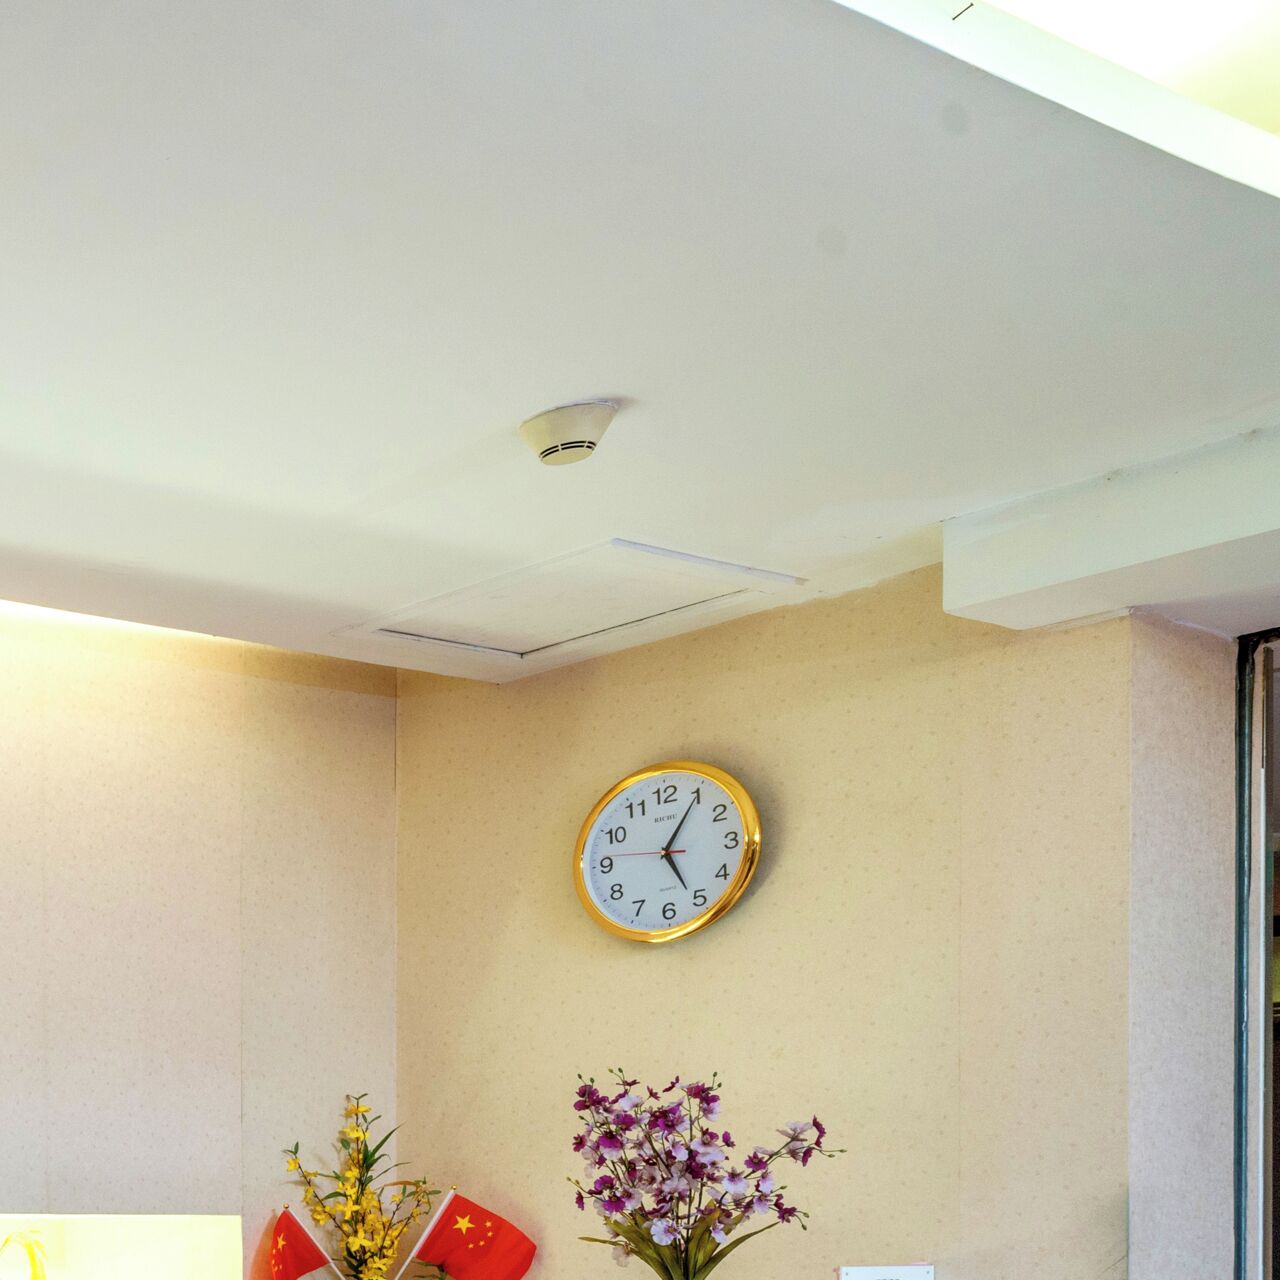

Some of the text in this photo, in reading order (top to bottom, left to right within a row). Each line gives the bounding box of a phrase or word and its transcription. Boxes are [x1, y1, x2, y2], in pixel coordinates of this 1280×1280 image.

[652, 785, 678, 806] 12
[691, 787, 701, 805] 1
[625, 799, 646, 819] 11
[712, 804, 728, 823] 2
[605, 826, 627, 845] 10
[724, 831, 739, 849] 3
[600, 856, 614, 874] 9
[714, 863, 730, 881] 4
[610, 883, 624, 900] 8
[692, 888, 708, 907] 5
[632, 899, 646, 917] 7
[662, 902, 677, 920] 6
